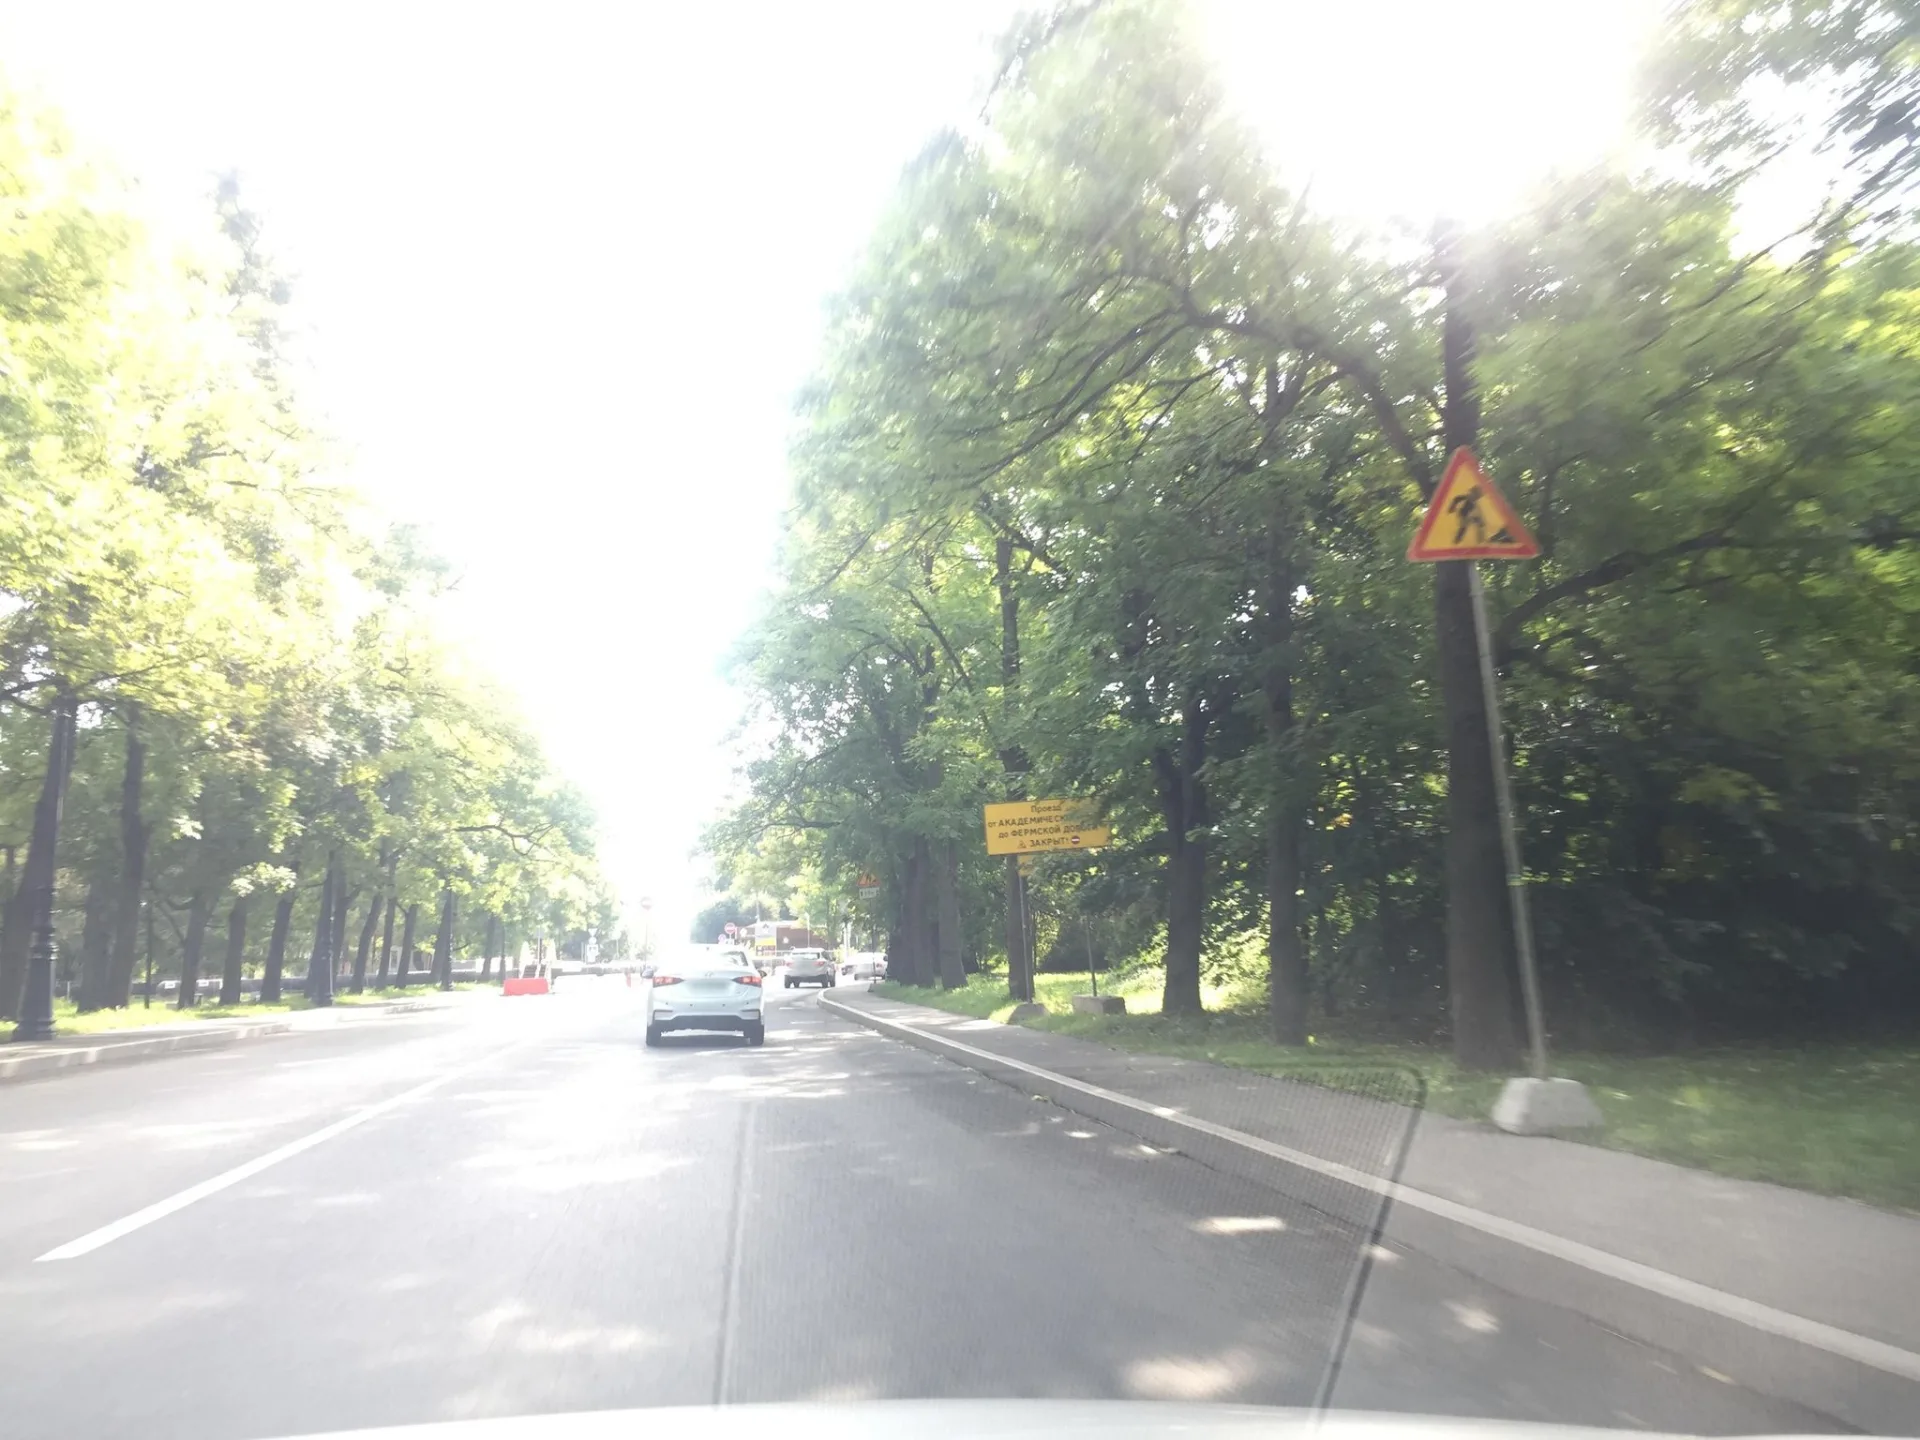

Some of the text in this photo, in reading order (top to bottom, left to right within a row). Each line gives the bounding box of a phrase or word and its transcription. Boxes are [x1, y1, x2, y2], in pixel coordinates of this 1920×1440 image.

[1030, 805, 1062, 813] Проезд
[998, 815, 1067, 827] АКАДЕМИЧЕСК
[998, 831, 1009, 839] до
[1011, 825, 1061, 838] ФЕРМСКОЙ
